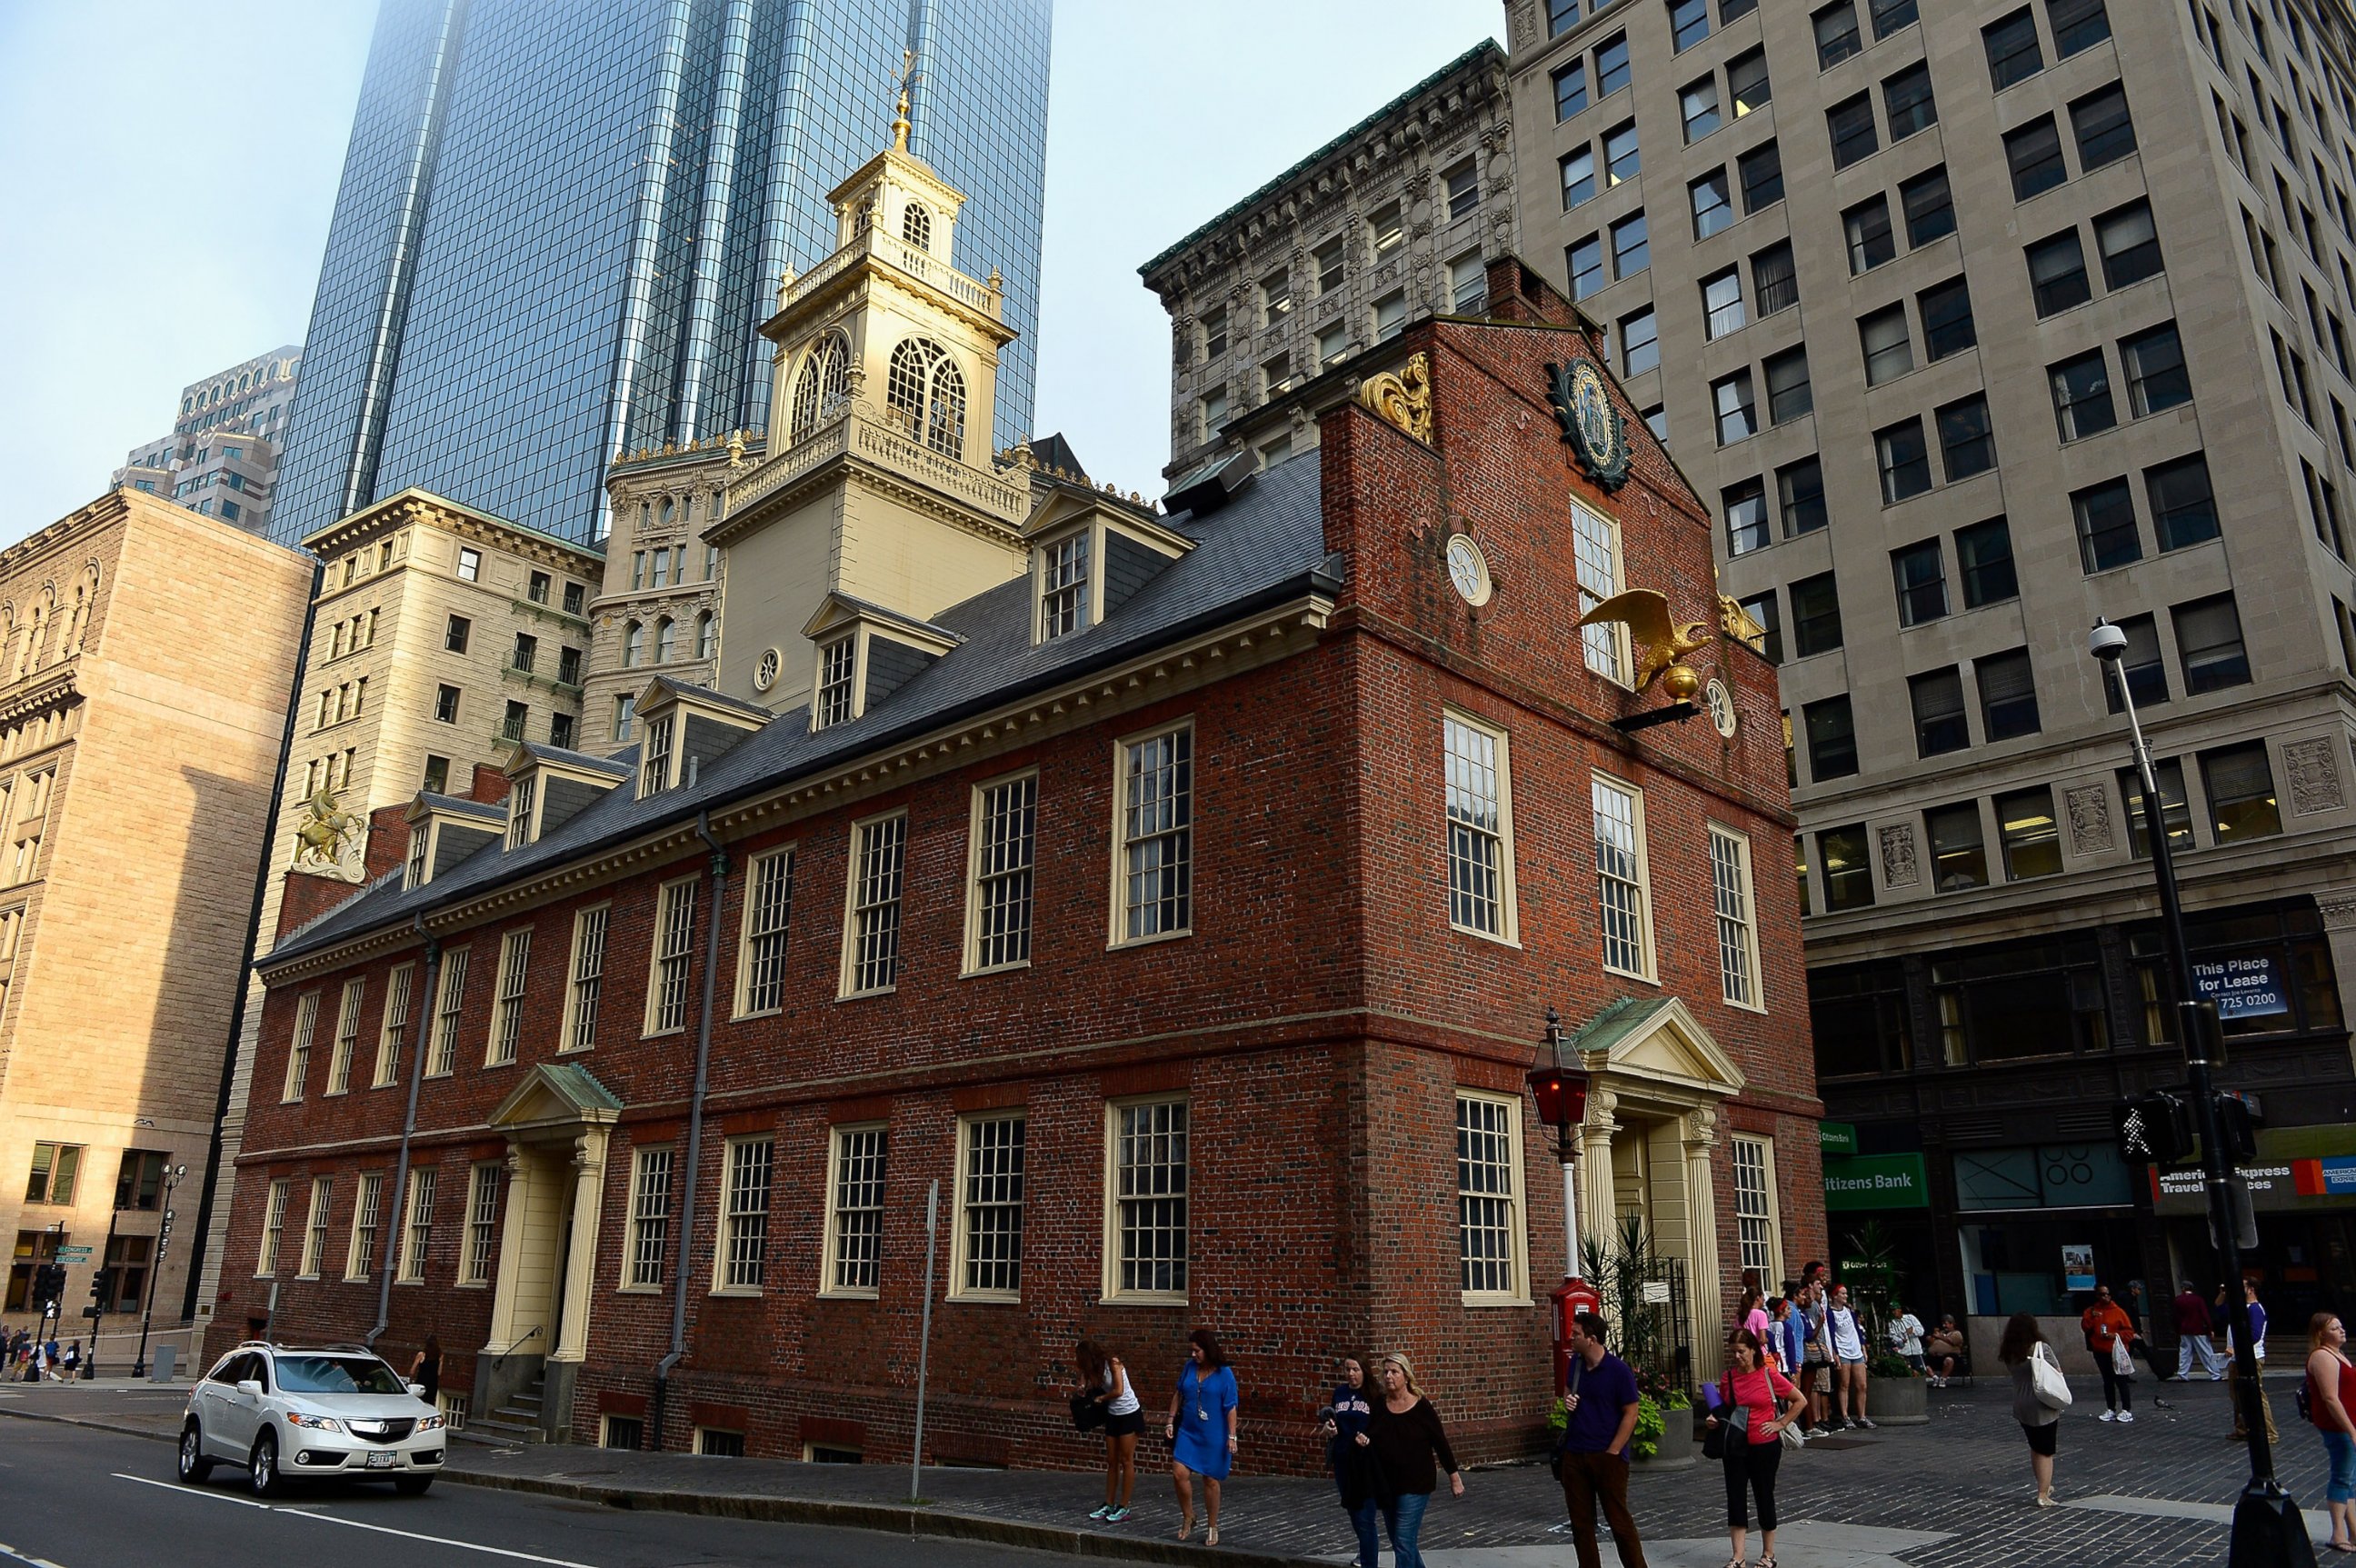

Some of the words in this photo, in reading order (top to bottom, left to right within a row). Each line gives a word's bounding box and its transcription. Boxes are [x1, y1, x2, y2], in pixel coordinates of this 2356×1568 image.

[2192, 964, 2224, 976] This
[2228, 958, 2269, 972] Place
[2199, 980, 2220, 992] for
[2223, 974, 2269, 988] Lease
[2221, 997, 2242, 1009] 725
[2246, 993, 2276, 1006] 0200
[1825, 1176, 1872, 1191] itizens
[1874, 1173, 1912, 1188] Bank
[2161, 1182, 2204, 1193] Travel
